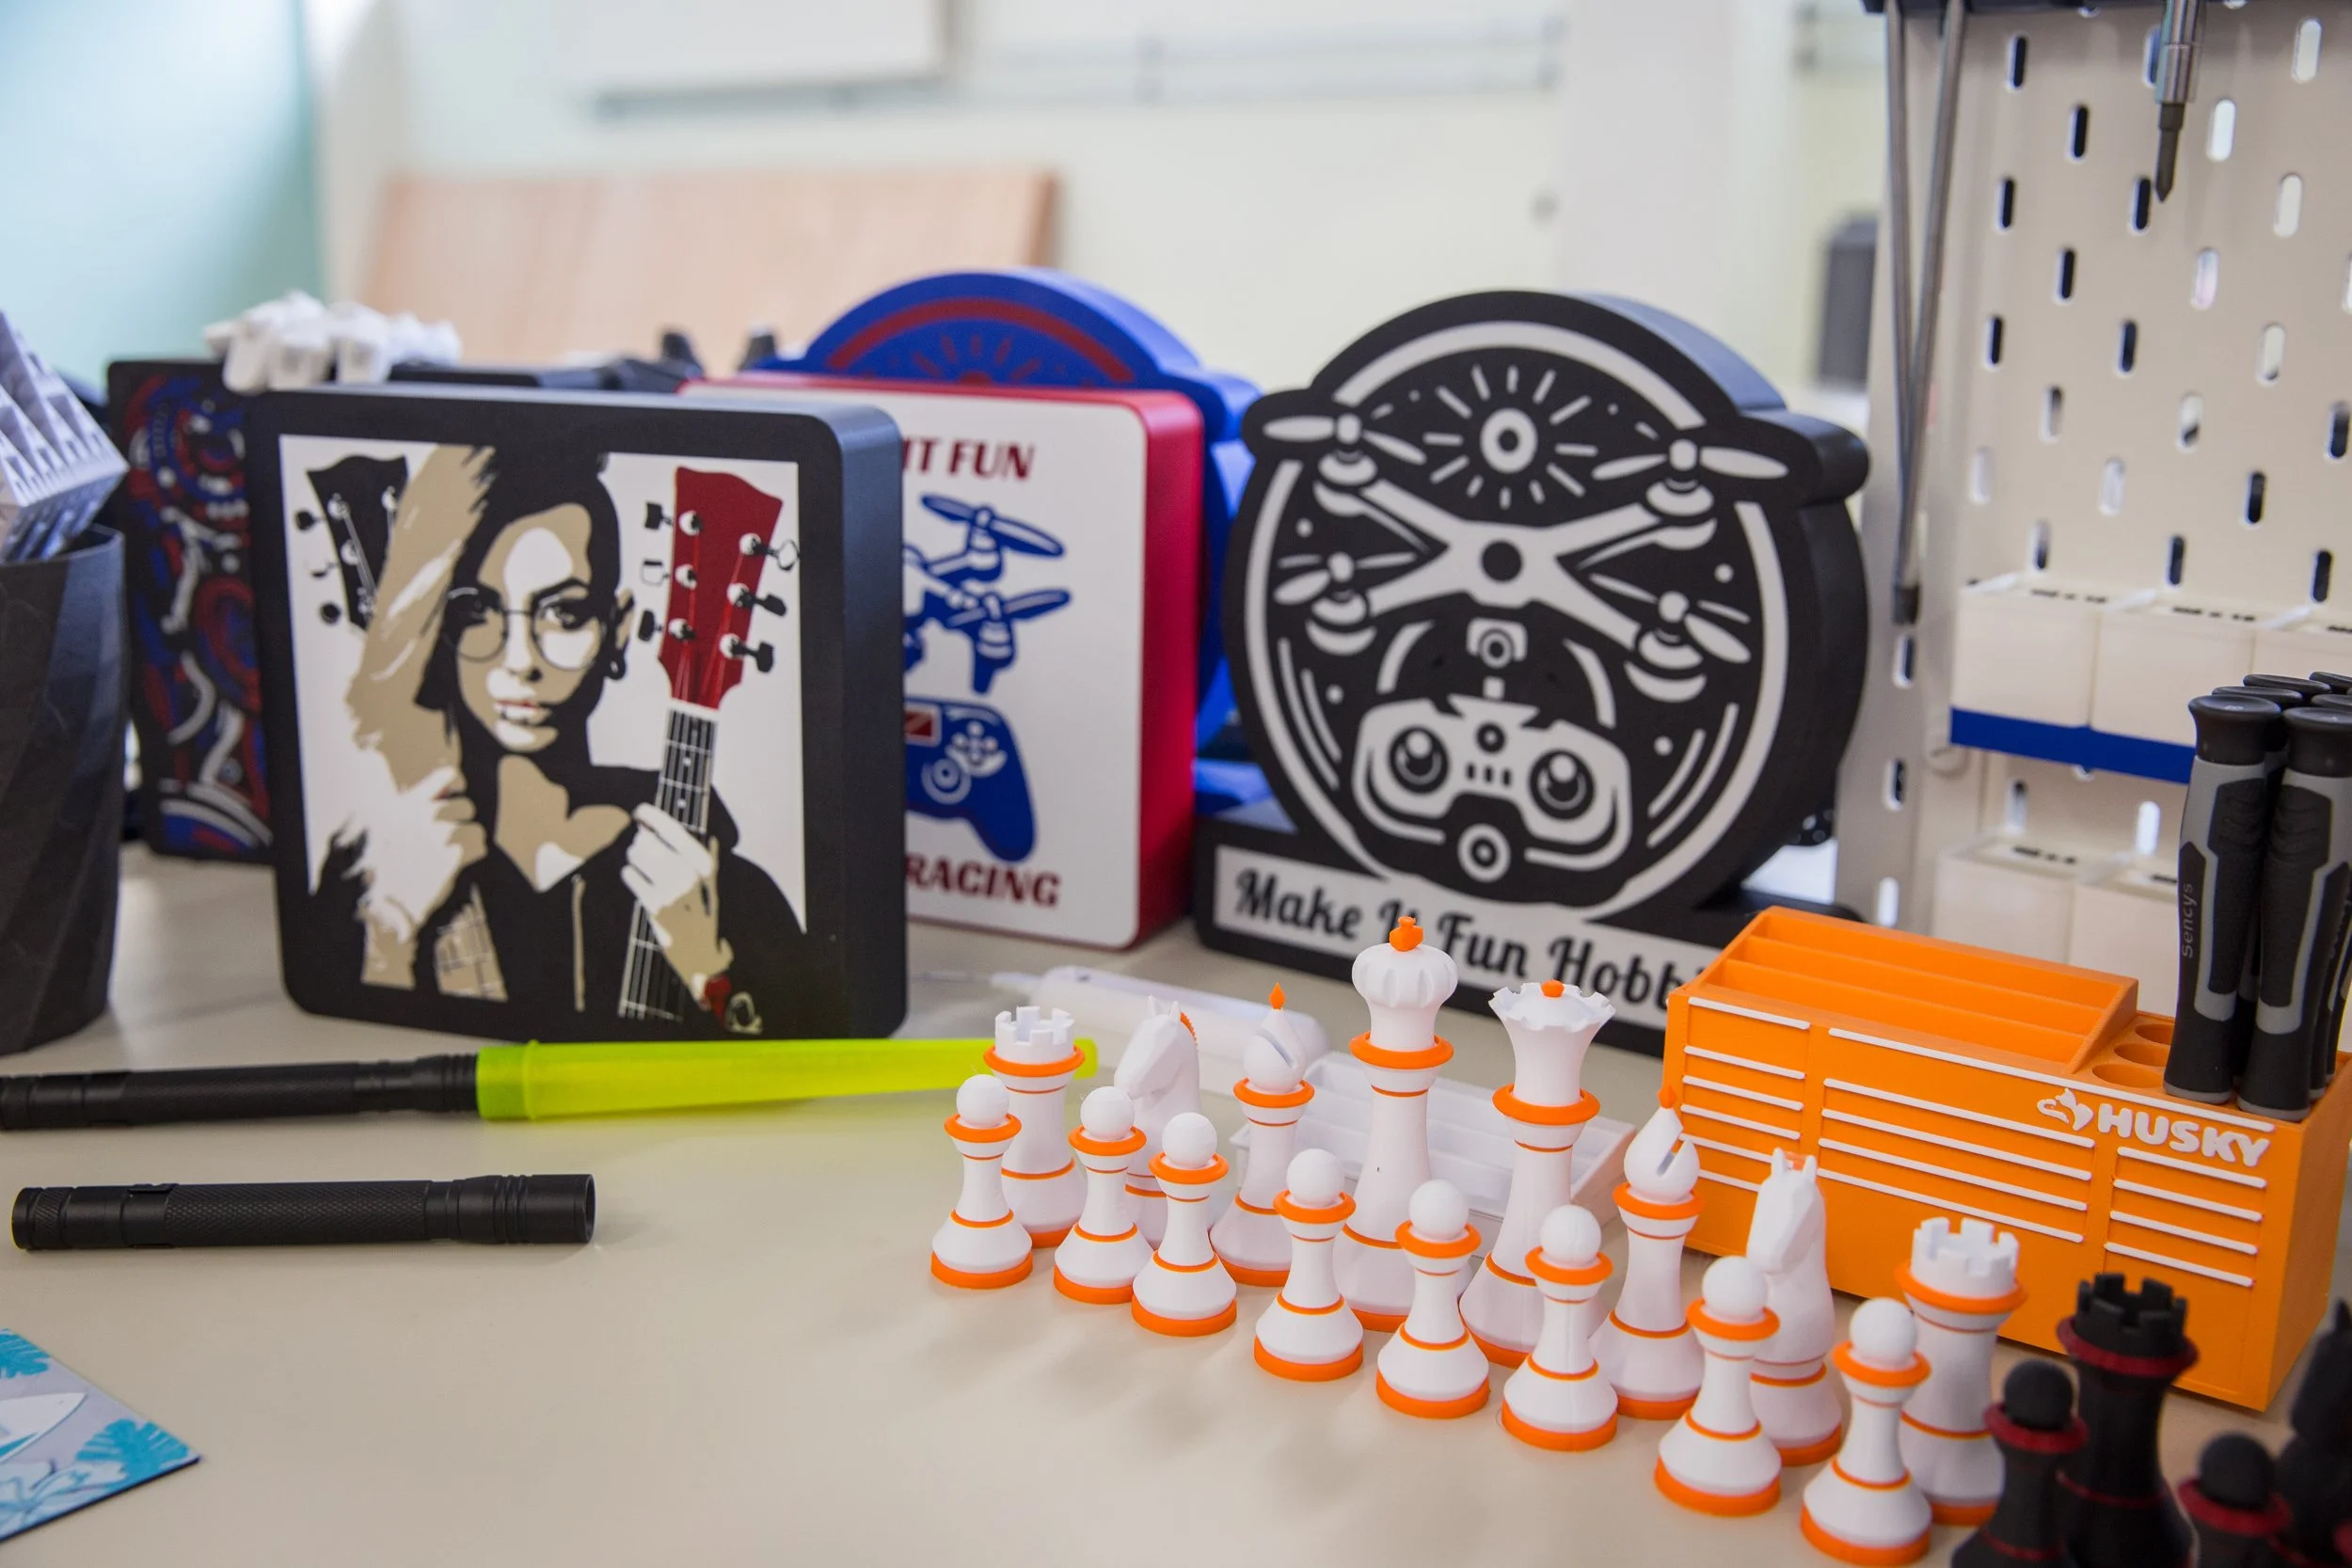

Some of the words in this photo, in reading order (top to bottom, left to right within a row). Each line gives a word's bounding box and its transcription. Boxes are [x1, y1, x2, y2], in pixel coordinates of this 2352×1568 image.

[948, 437, 1036, 481] FUN
[905, 852, 1061, 908] RACING
[1235, 867, 1362, 940] Make
[1438, 909, 1529, 979] Fun
[1547, 935, 1705, 1013] Hobb
[2182, 882, 2198, 958] Sencys
[2097, 1102, 2270, 1167] HUSKY
